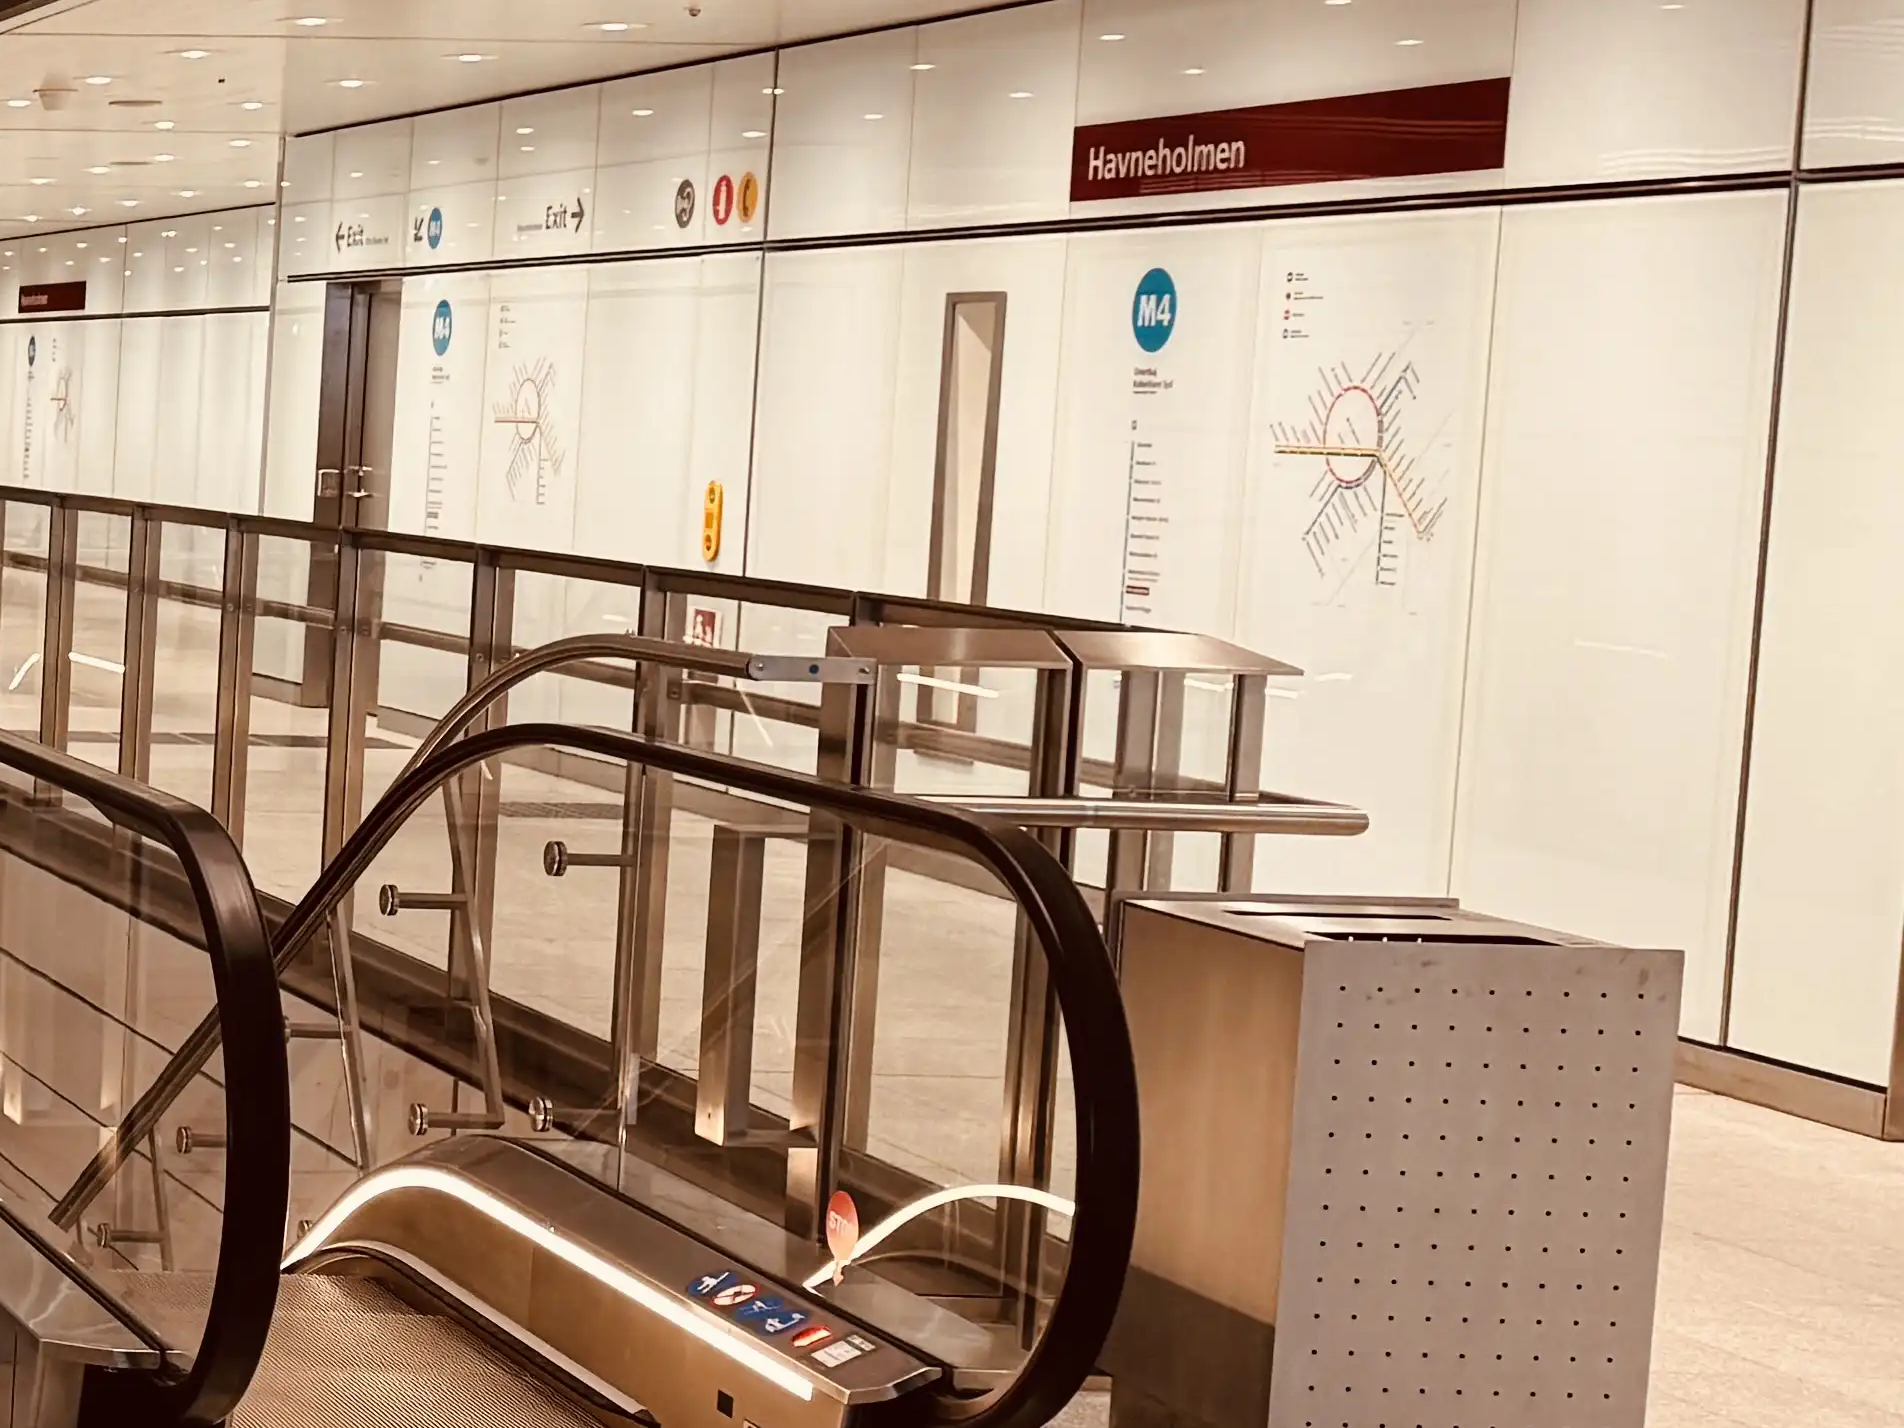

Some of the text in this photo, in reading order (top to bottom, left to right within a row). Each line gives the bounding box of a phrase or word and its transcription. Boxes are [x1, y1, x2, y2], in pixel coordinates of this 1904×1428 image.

[1088, 134, 1245, 181] Havneholmen
[545, 203, 567, 229] Exit
[1137, 293, 1171, 327] M4
